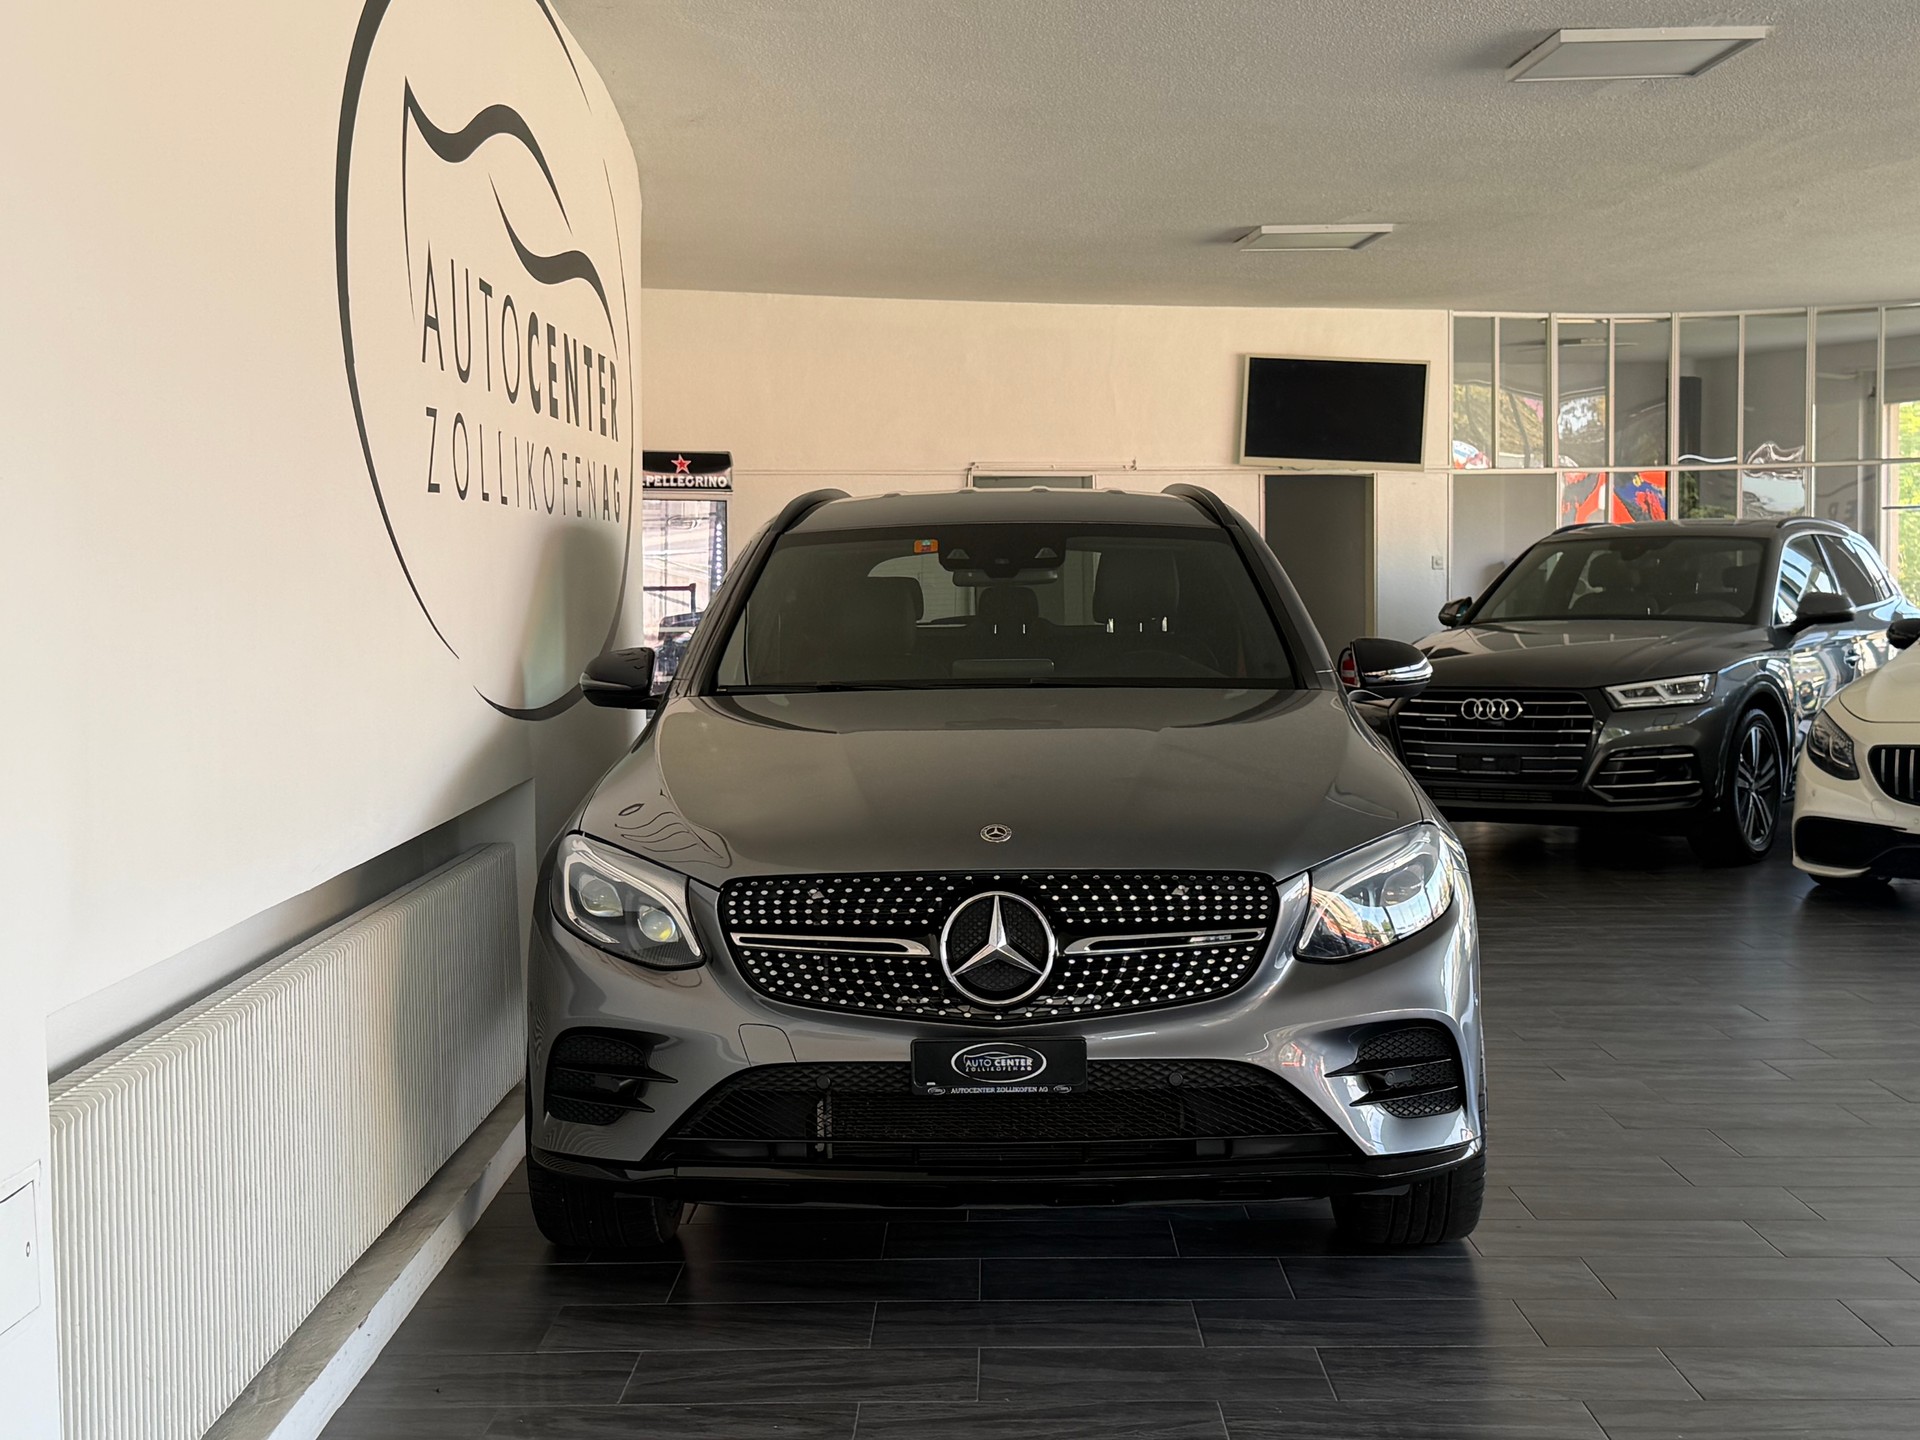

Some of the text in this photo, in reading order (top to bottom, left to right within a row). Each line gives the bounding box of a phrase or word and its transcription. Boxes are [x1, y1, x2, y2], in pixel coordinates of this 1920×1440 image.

[422, 240, 618, 442] AUTOCENTER
[966, 1058, 1033, 1067] AUTO CENTER
